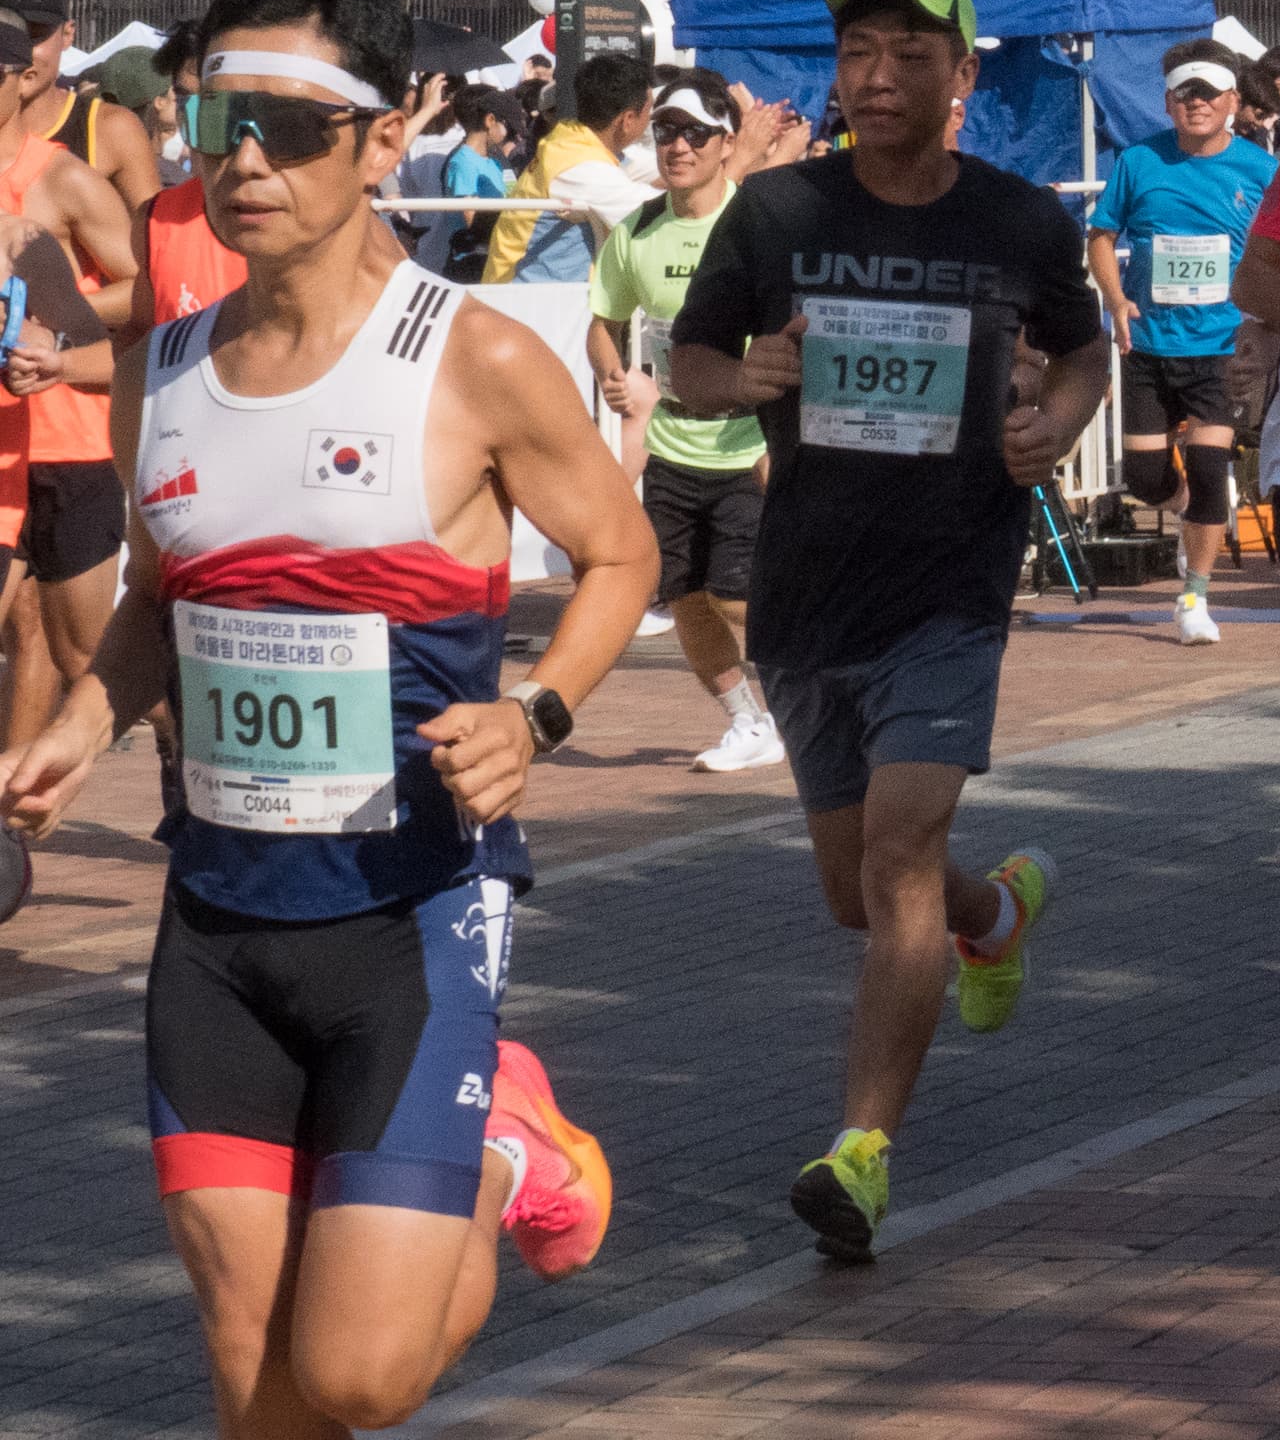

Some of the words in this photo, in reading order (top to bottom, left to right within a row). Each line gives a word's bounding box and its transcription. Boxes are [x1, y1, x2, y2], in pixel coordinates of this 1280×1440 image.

[1167, 260, 1216, 279] 1276
[832, 354, 938, 396] 1987
[239, 641, 325, 665] 마라톤대회
[207, 687, 339, 750] 1901
[243, 794, 292, 813] C0044
